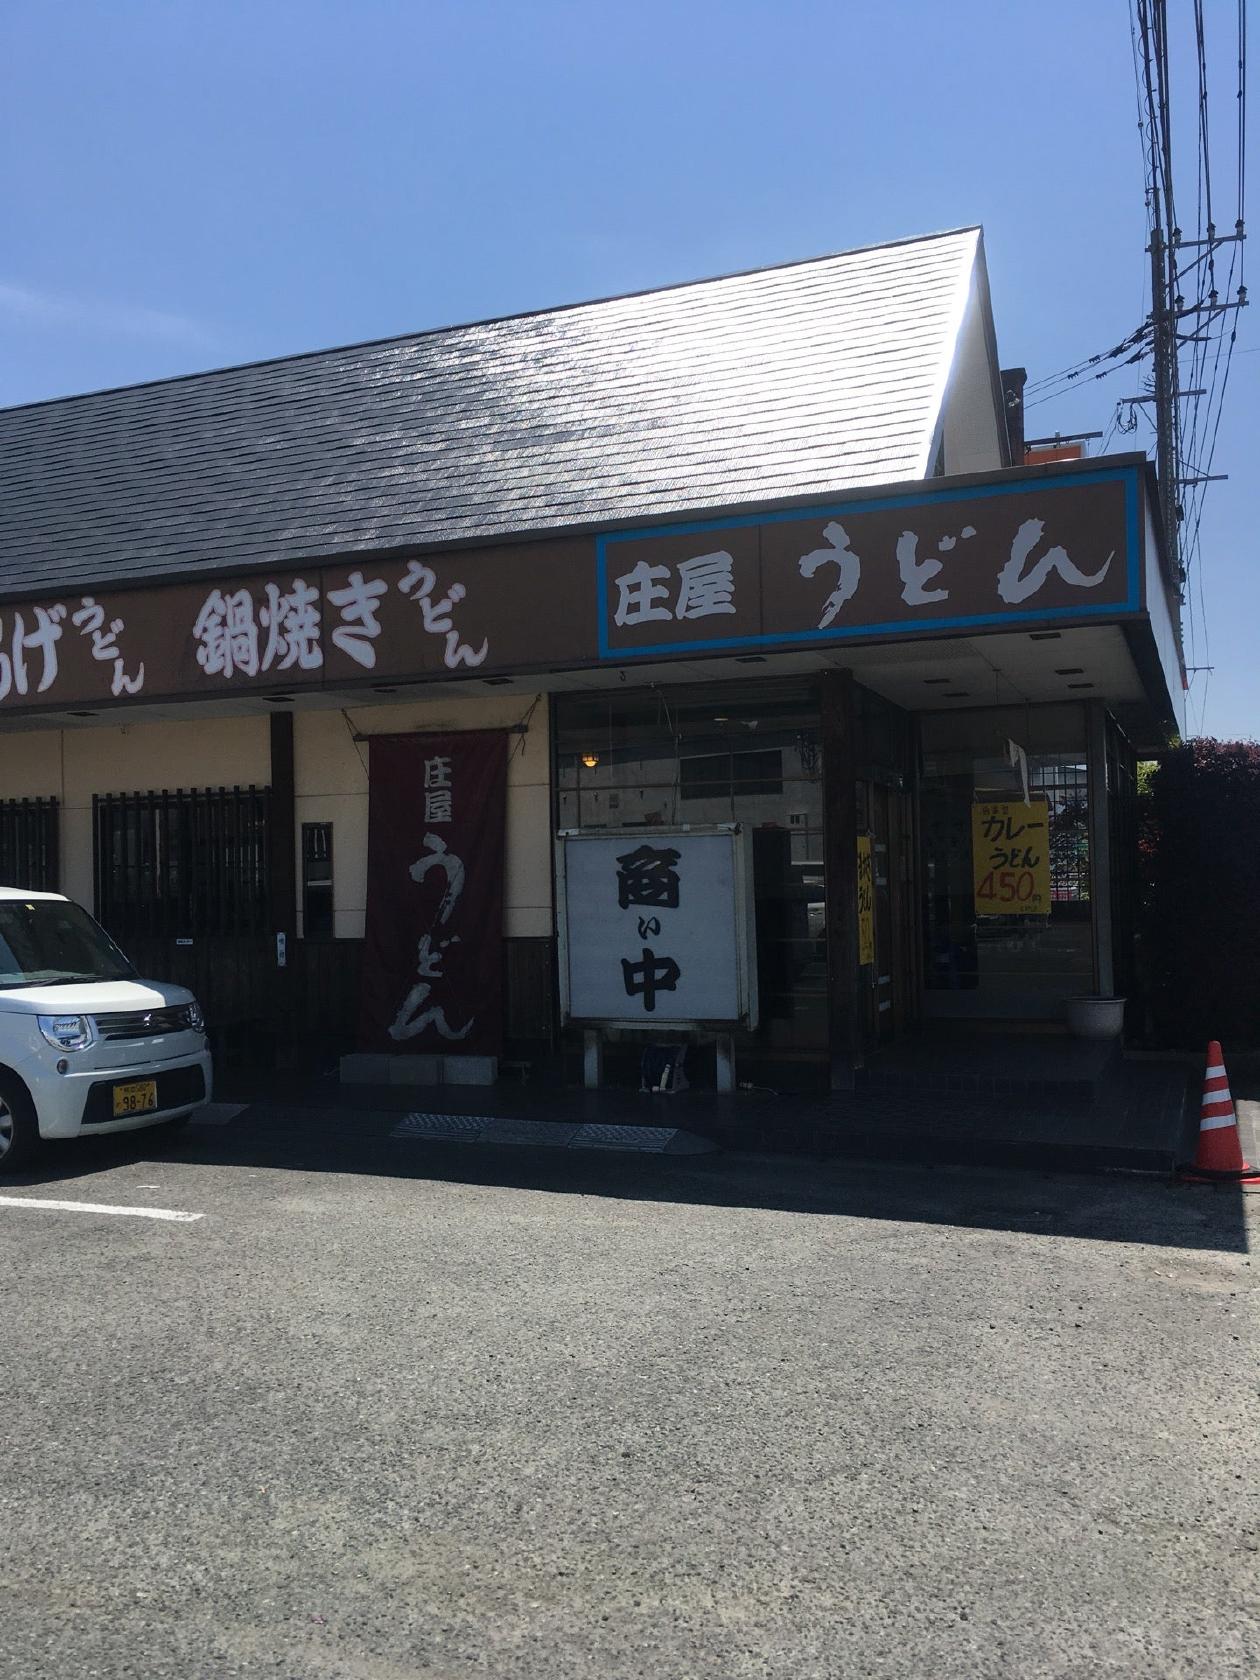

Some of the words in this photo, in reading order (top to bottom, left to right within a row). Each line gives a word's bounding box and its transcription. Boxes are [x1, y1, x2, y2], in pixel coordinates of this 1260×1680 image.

[982, 816, 1044, 842] カレー
[989, 846, 1040, 870] うどん
[616, 845, 681, 1012] 商い中
